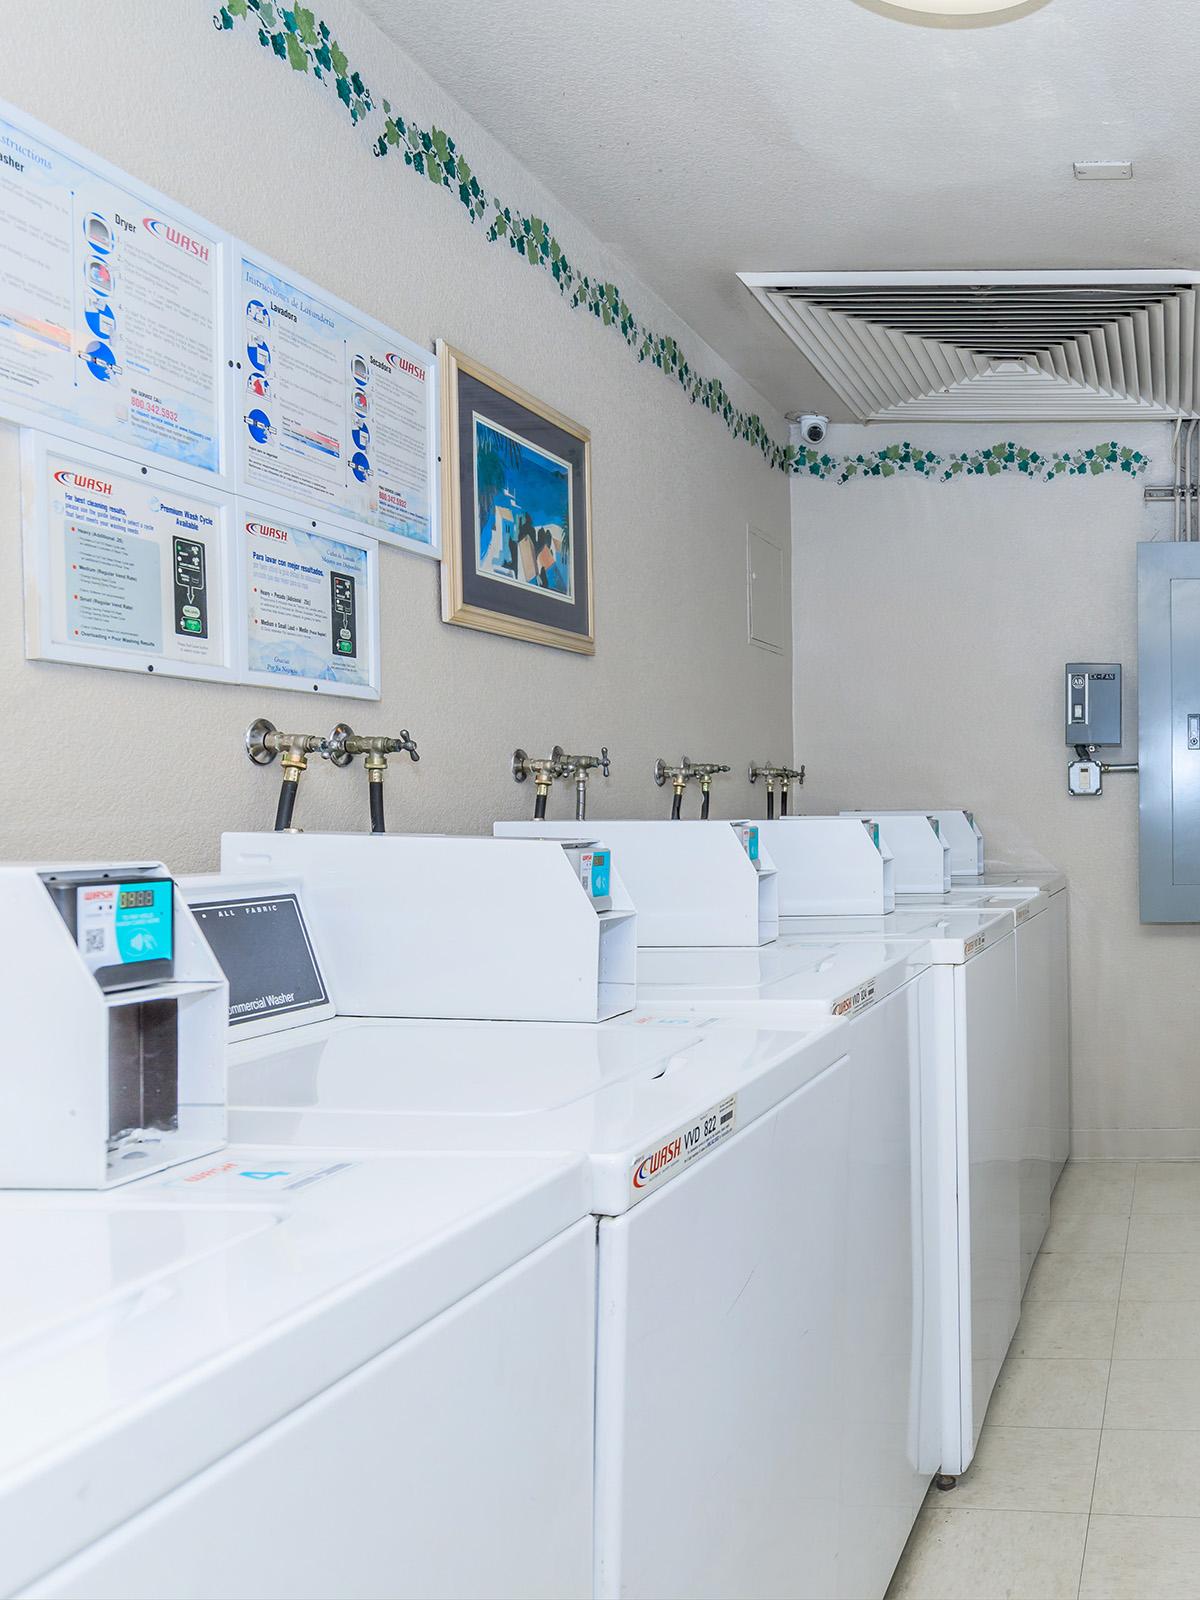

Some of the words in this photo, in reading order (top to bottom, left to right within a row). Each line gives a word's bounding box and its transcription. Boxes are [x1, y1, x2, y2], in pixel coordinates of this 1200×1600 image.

[115, 213, 136, 233] Dryer
[166, 225, 209, 262] WASH
[270, 301, 298, 323] Lavadora
[370, 356, 392, 373] Secadora
[400, 358, 426, 381] WASH
[74, 474, 112, 495] WASH
[74, 494, 85, 504] best
[87, 497, 108, 512] cleaning
[160, 504, 183, 517] Premium
[184, 510, 198, 521] Wash
[200, 514, 213, 526] Cycle
[176, 518, 199, 531] Available
[260, 524, 288, 541] WASH
[252, 551, 264, 561] Para
[265, 554, 277, 564] lavar
[287, 561, 299, 571] mejor
[218, 910, 235, 918] ALL
[245, 905, 278, 914] FABRIC
[228, 996, 267, 1015] ommercial
[266, 992, 295, 1006] Washer
[650, 1136, 682, 1175] WASH
[704, 1115, 717, 1137] 822
